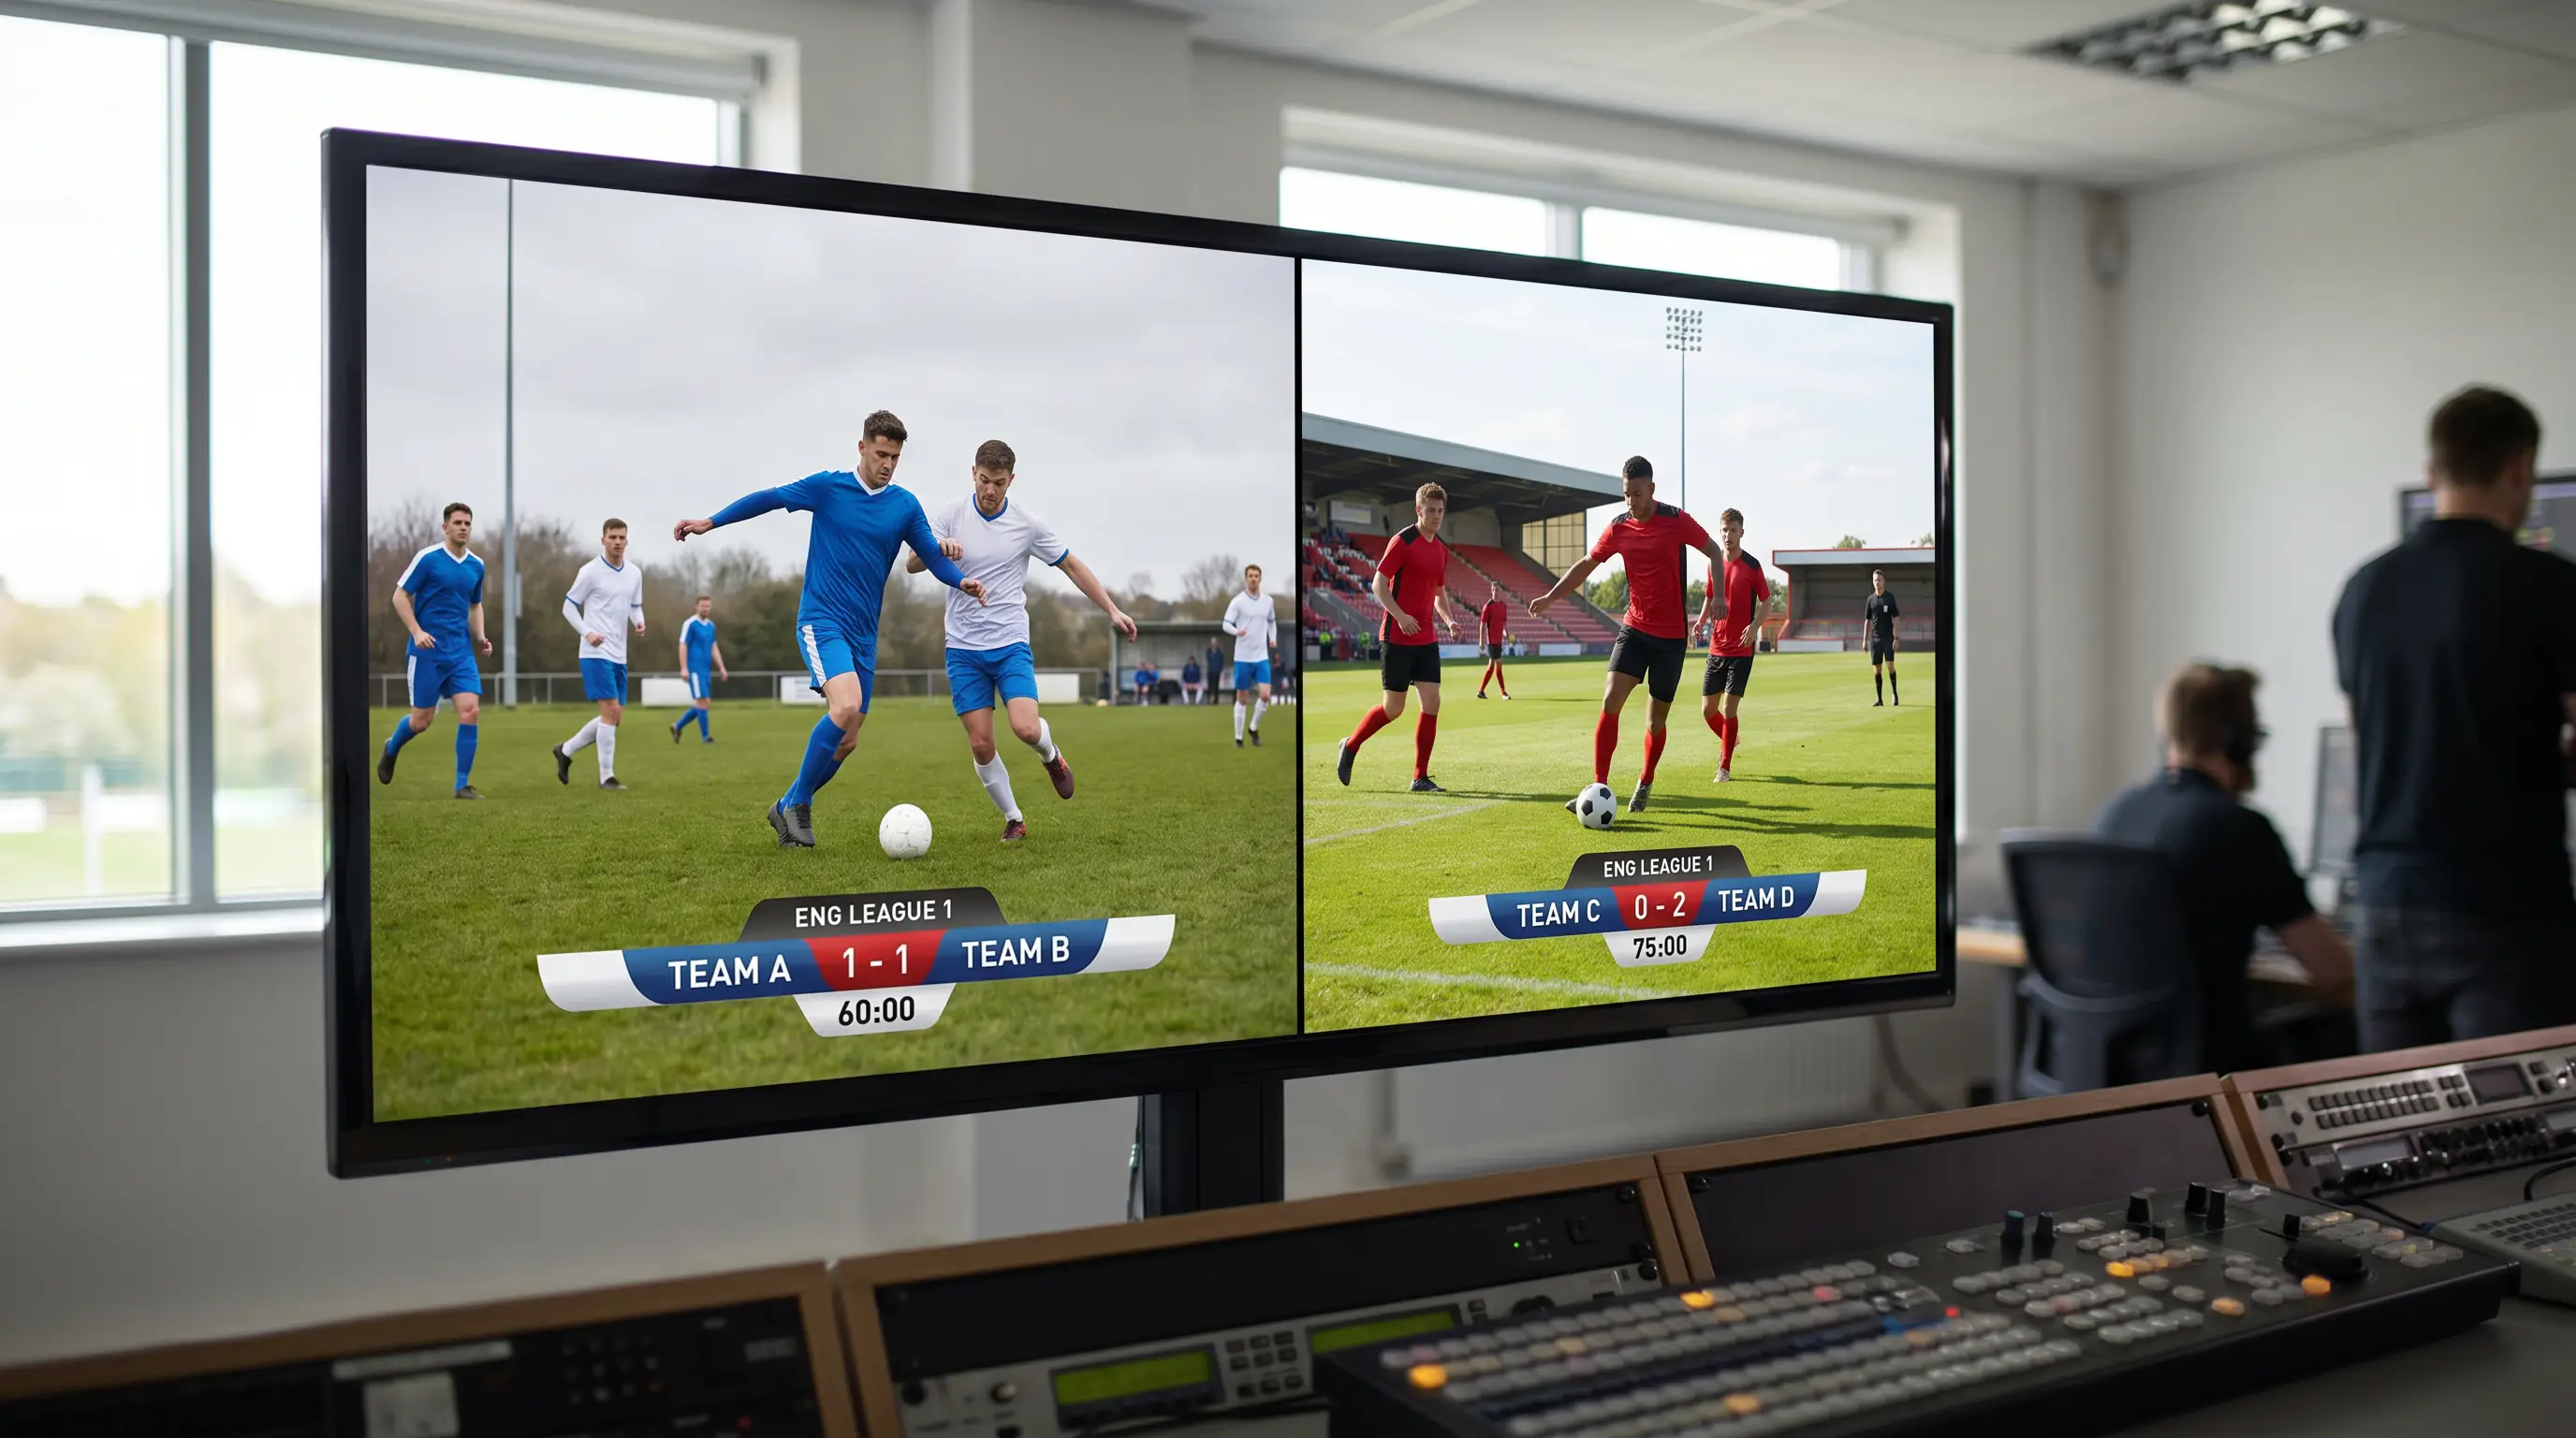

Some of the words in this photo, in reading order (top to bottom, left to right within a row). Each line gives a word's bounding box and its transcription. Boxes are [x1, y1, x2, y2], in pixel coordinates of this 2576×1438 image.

[1603, 859, 1636, 878] ENG
[1640, 856, 1702, 876] LEAGUE
[1705, 855, 1713, 872] 1
[796, 905, 842, 928] ENG
[849, 900, 936, 925] LEAGUE
[943, 899, 952, 919] 1
[1516, 900, 1579, 928] TEAM
[1587, 899, 1601, 922] C
[1634, 894, 1647, 920] 0
[1673, 890, 1686, 917] 2
[1718, 887, 1775, 912] TEAM
[1781, 886, 1794, 908] D
[1633, 934, 1687, 960] 75:00
[667, 956, 759, 990] TEAM
[768, 954, 792, 983] A
[842, 947, 855, 978] 1
[896, 944, 907, 975] 1
[961, 936, 1042, 968] TEAM
[1052, 935, 1070, 962] B
[838, 995, 915, 1027] 60:00
